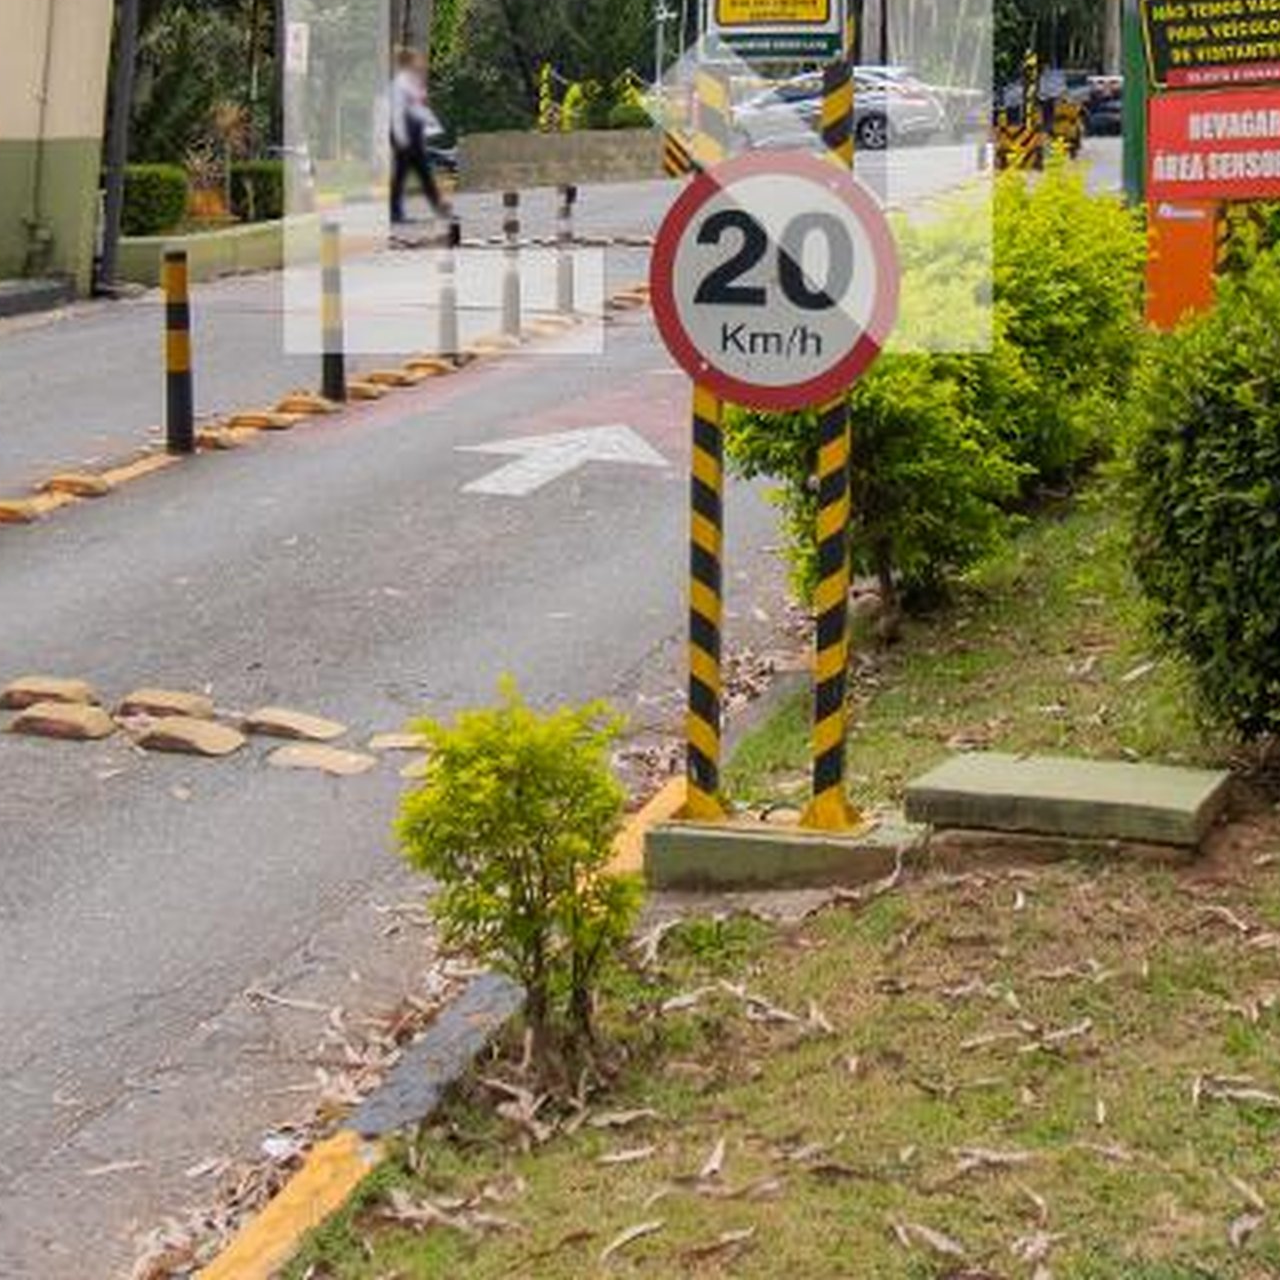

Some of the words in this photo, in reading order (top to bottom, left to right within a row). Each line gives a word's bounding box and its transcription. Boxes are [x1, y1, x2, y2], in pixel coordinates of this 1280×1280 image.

[1152, 2, 1187, 21] NÃO
[1191, 0, 1244, 18] TEMOS
[1167, 25, 1208, 42] PARA
[1153, 150, 1205, 181] ÁREA
[693, 209, 855, 311] 20
[721, 323, 822, 357] Km/h
